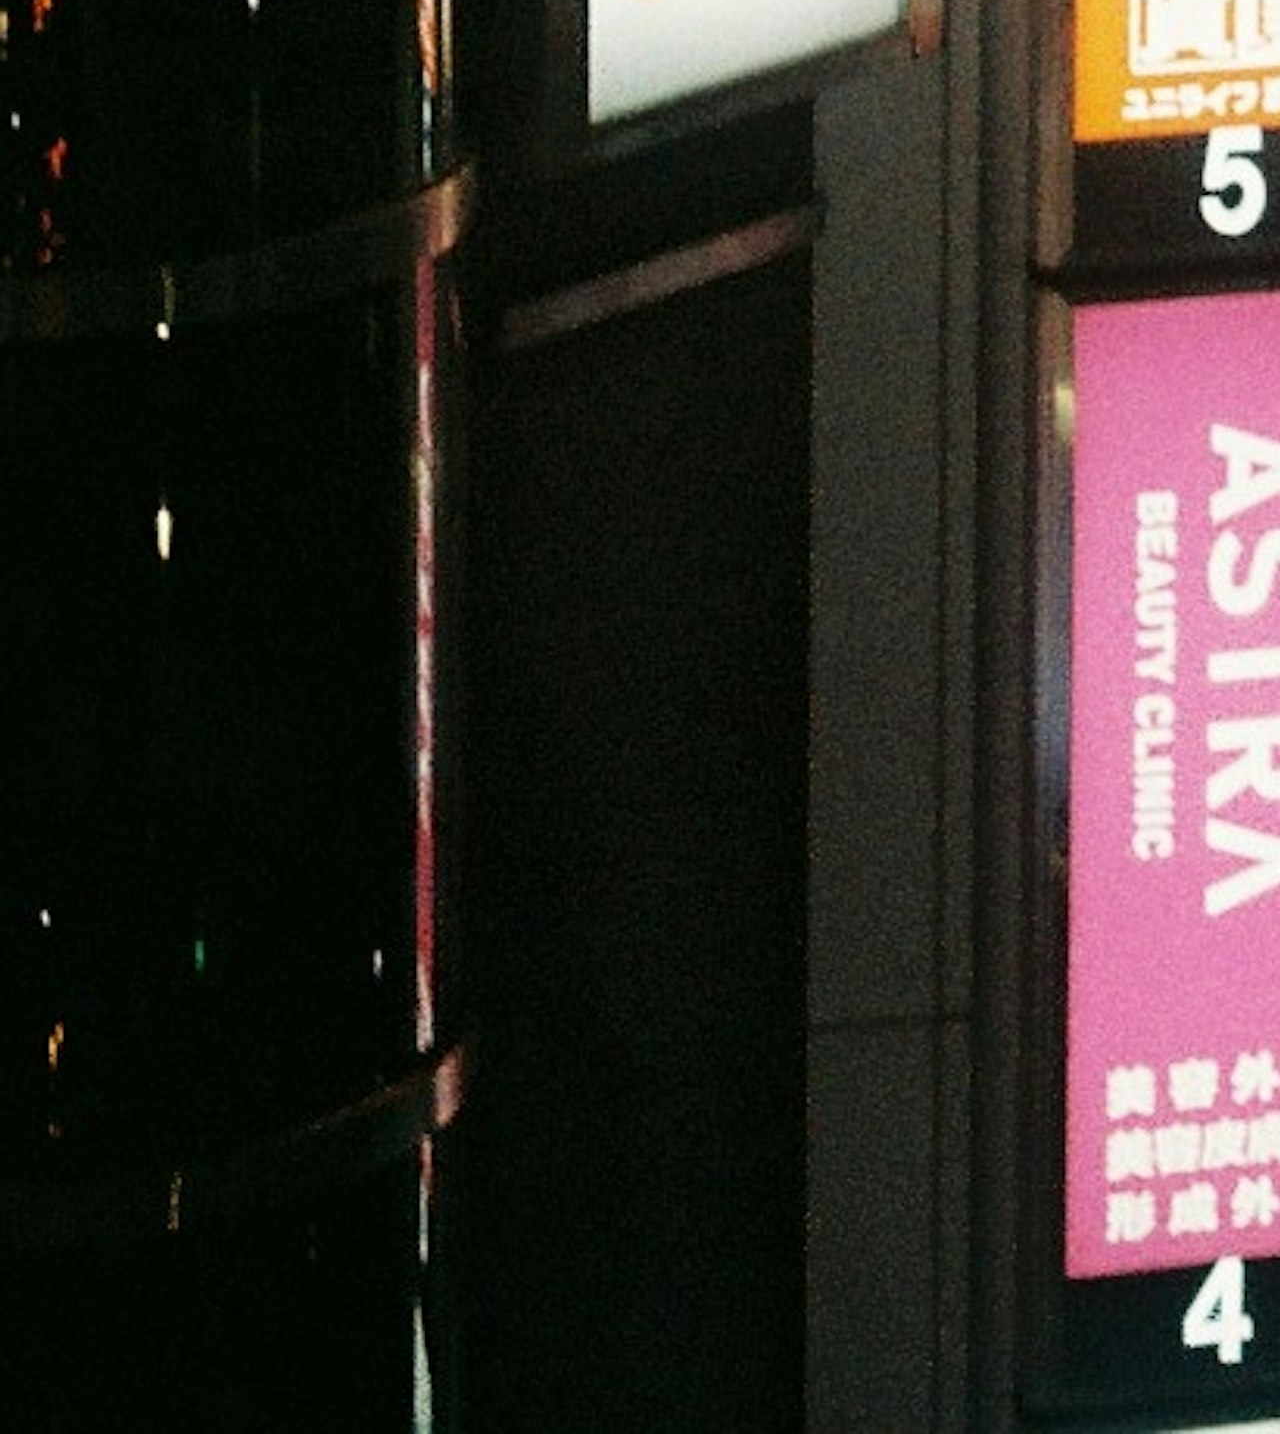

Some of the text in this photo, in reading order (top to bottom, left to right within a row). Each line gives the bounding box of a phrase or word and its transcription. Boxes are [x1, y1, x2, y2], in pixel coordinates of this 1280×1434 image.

[1198, 124, 1268, 237] 5
[1132, 490, 1179, 862] BEAUTY CLINIC
[1181, 1255, 1255, 1364] 4
